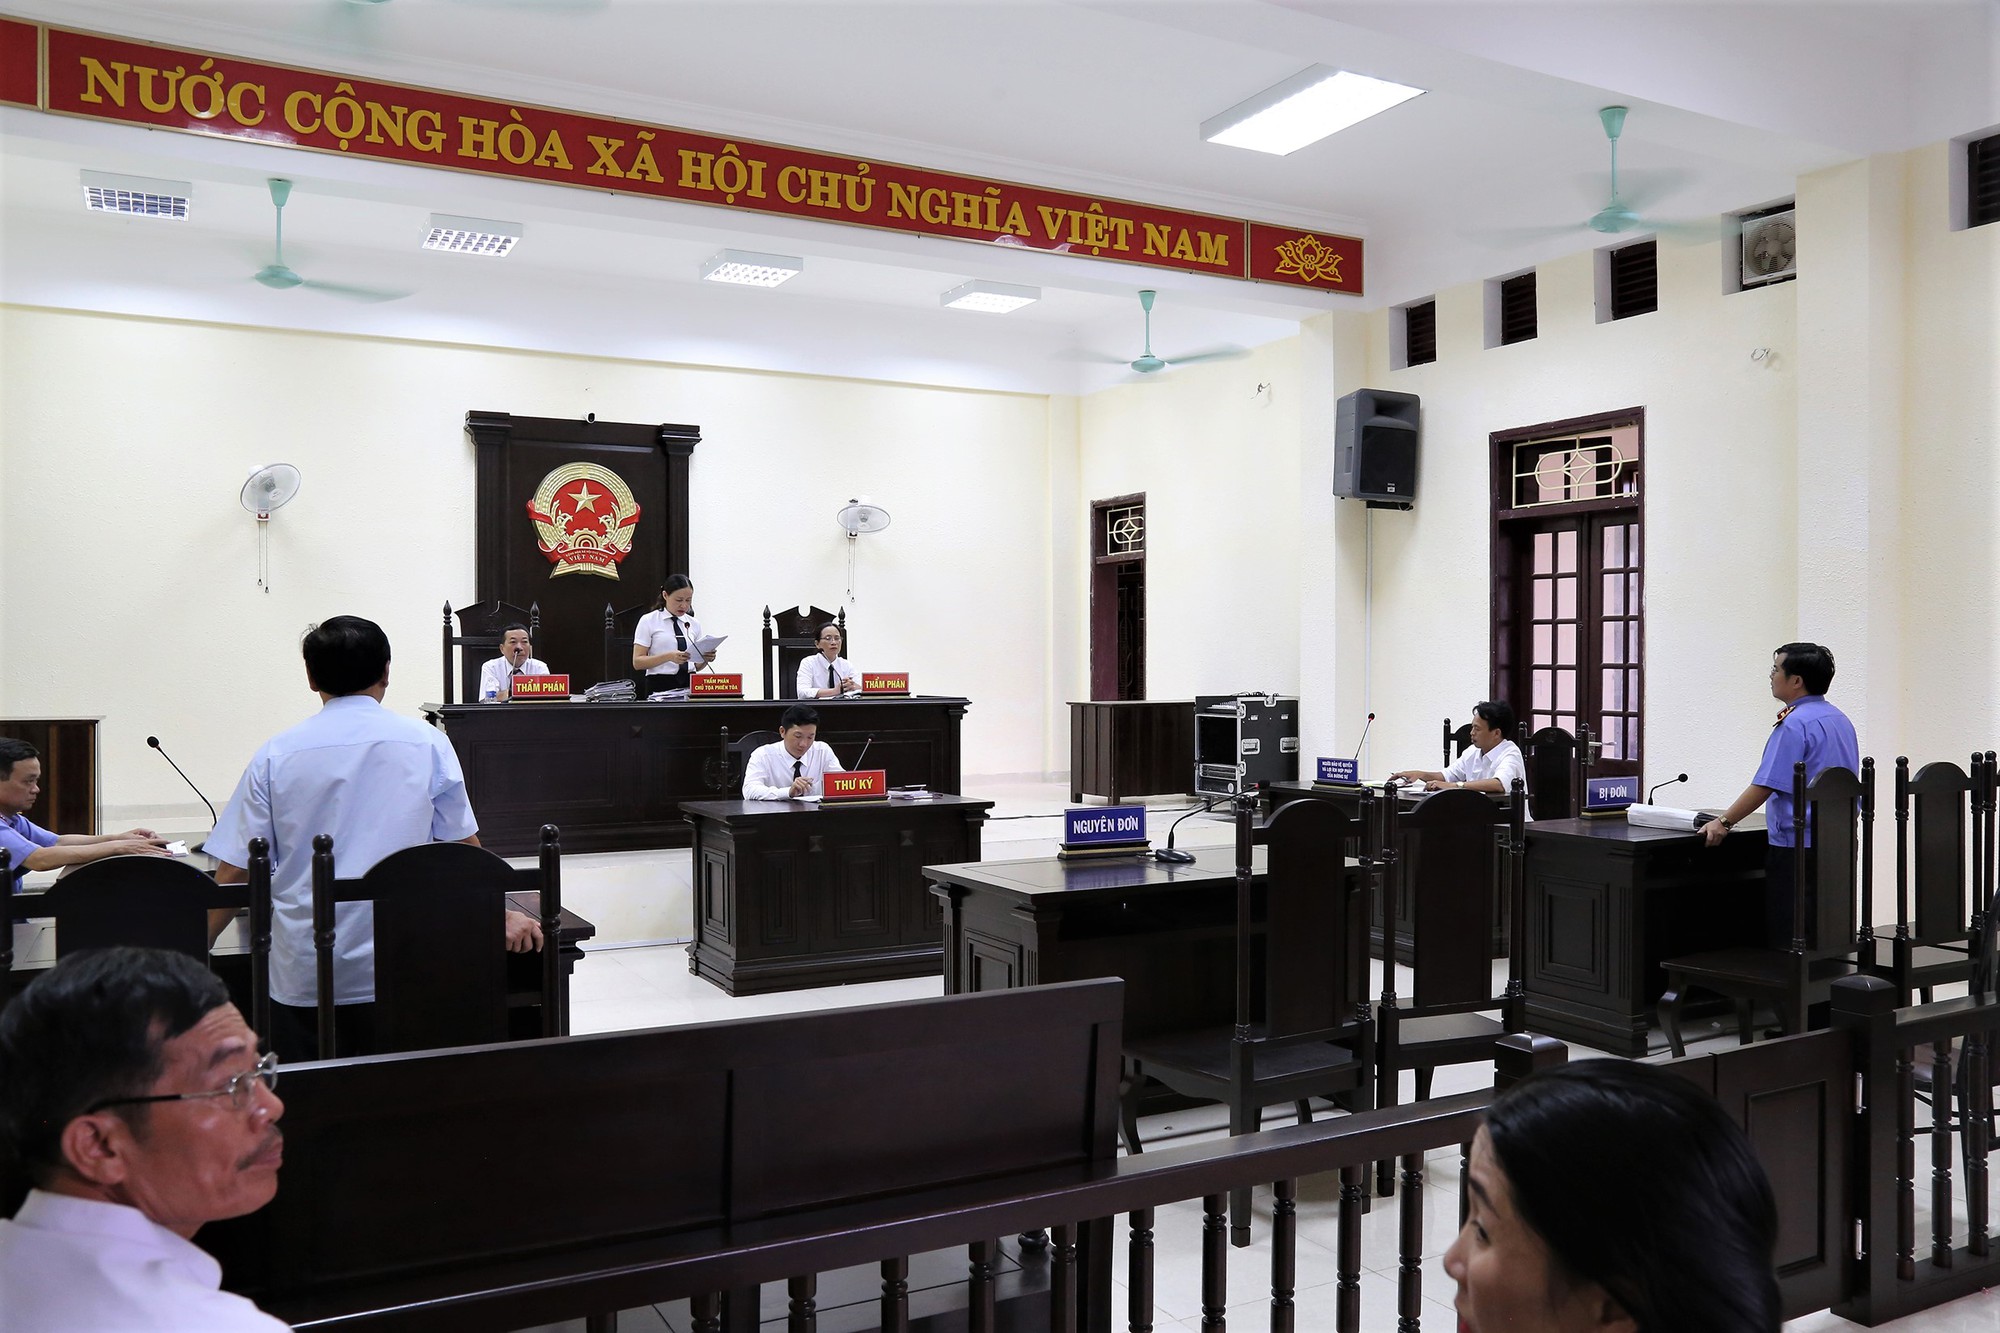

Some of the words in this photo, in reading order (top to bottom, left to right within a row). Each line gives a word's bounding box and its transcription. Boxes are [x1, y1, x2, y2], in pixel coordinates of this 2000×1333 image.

[80, 57, 266, 127] NƯỚC
[283, 82, 448, 153] CỘNG
[457, 109, 573, 169] HÒA
[587, 131, 664, 184] XÃ
[678, 143, 768, 205] HỘI
[777, 161, 876, 213] CHỦ
[887, 186, 1030, 237] NGHĨA
[1038, 202, 1134, 257] VIỆT
[1143, 222, 1230, 266] NAM
[569, 554, 586, 562] VIỆT
[589, 554, 605, 563] NAM
[516, 678, 540, 692] THẨM
[542, 680, 565, 692] PHÁN
[865, 676, 885, 689] THẨM
[886, 677, 905, 689] PHÁN
[834, 777, 857, 791] THƯ
[859, 776, 873, 790] KÝ
[1599, 787, 1608, 801] BỊ
[1610, 785, 1627, 798] ĐƠN
[1073, 815, 1115, 834] NGUYÊN
[1117, 815, 1139, 832] ĐƠN
